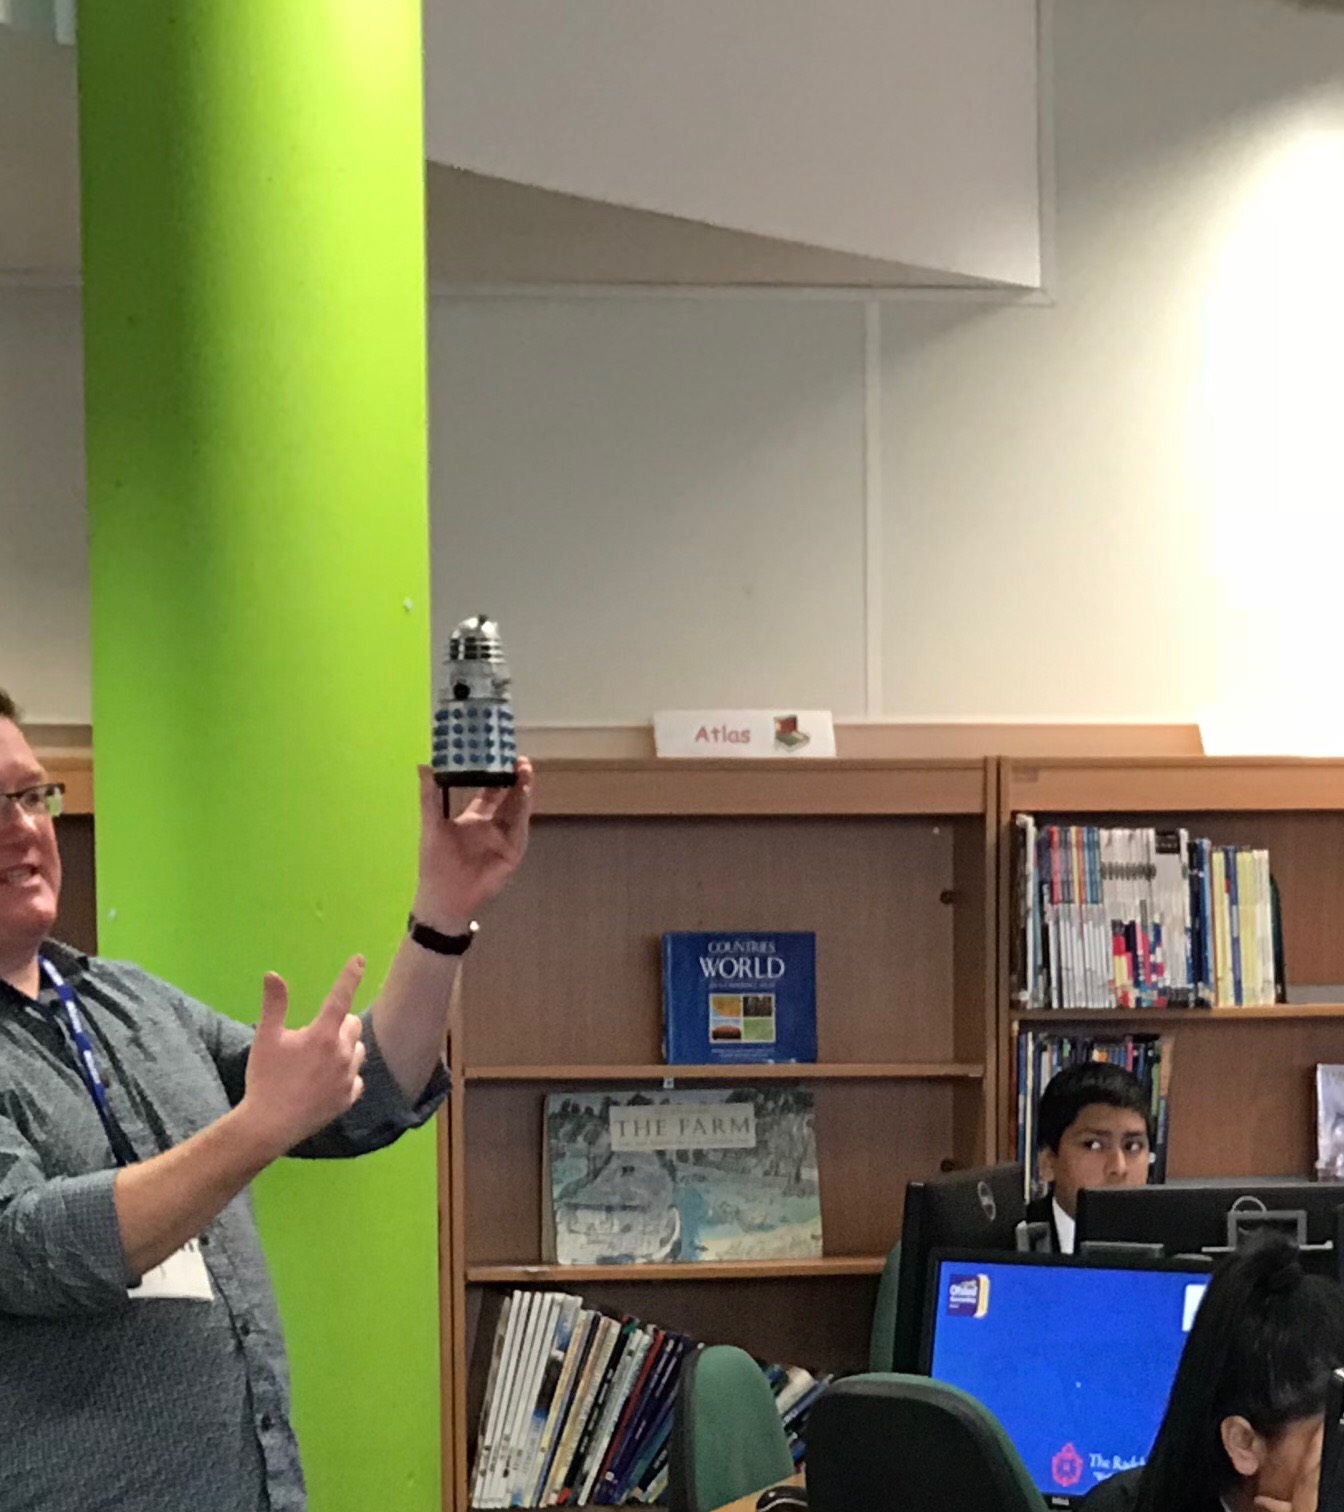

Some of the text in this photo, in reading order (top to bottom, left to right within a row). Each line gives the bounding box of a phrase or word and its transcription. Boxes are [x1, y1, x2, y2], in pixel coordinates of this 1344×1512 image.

[695, 725, 751, 743] Atlas
[707, 941, 776, 953] COUNTRIES
[699, 955, 785, 979] WORLD
[612, 1116, 751, 1138] THE FARM
[1089, 1453, 1111, 1469] The
